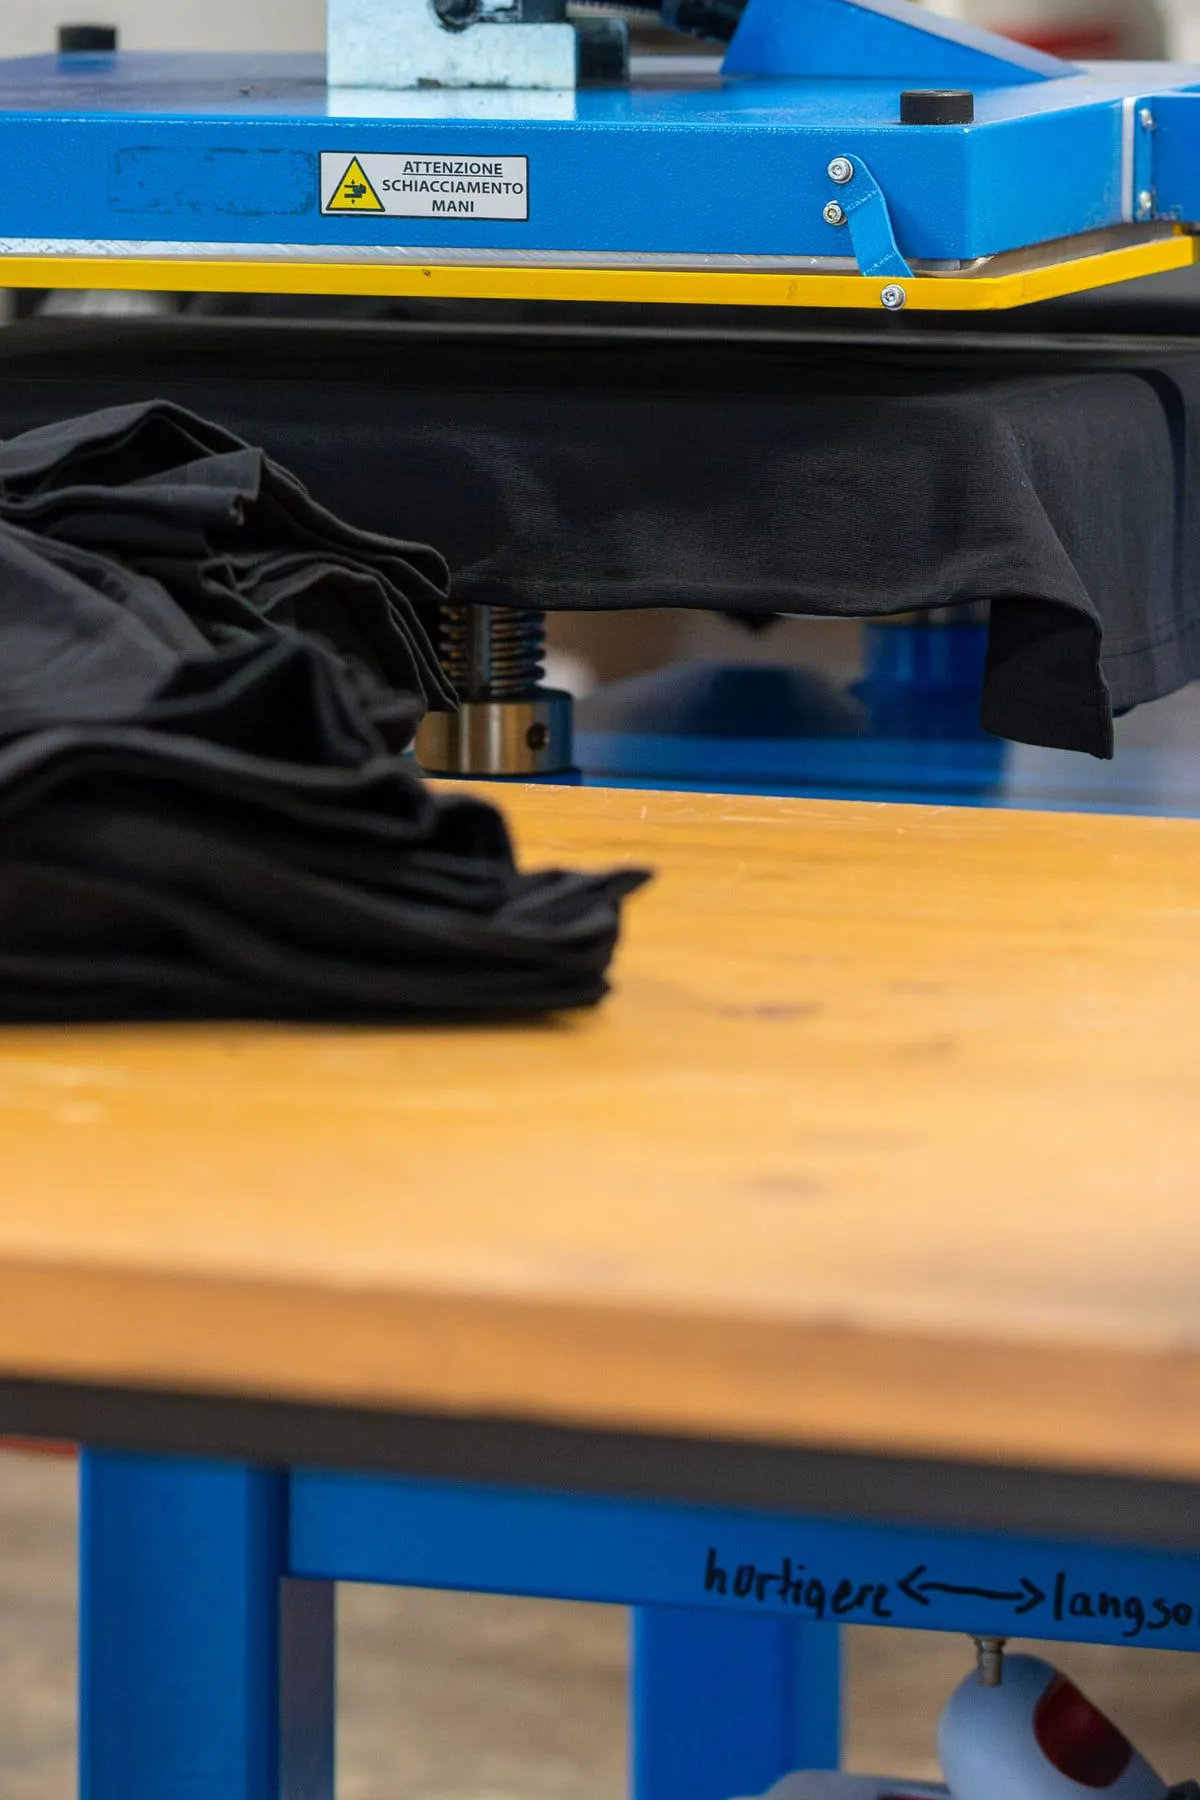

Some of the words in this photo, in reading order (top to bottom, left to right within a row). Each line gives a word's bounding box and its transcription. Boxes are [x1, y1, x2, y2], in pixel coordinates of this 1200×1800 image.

[403, 160, 503, 176] ATTENZIONE
[382, 179, 524, 195] SCHIACCIAMENTO
[431, 199, 475, 213] MANI
